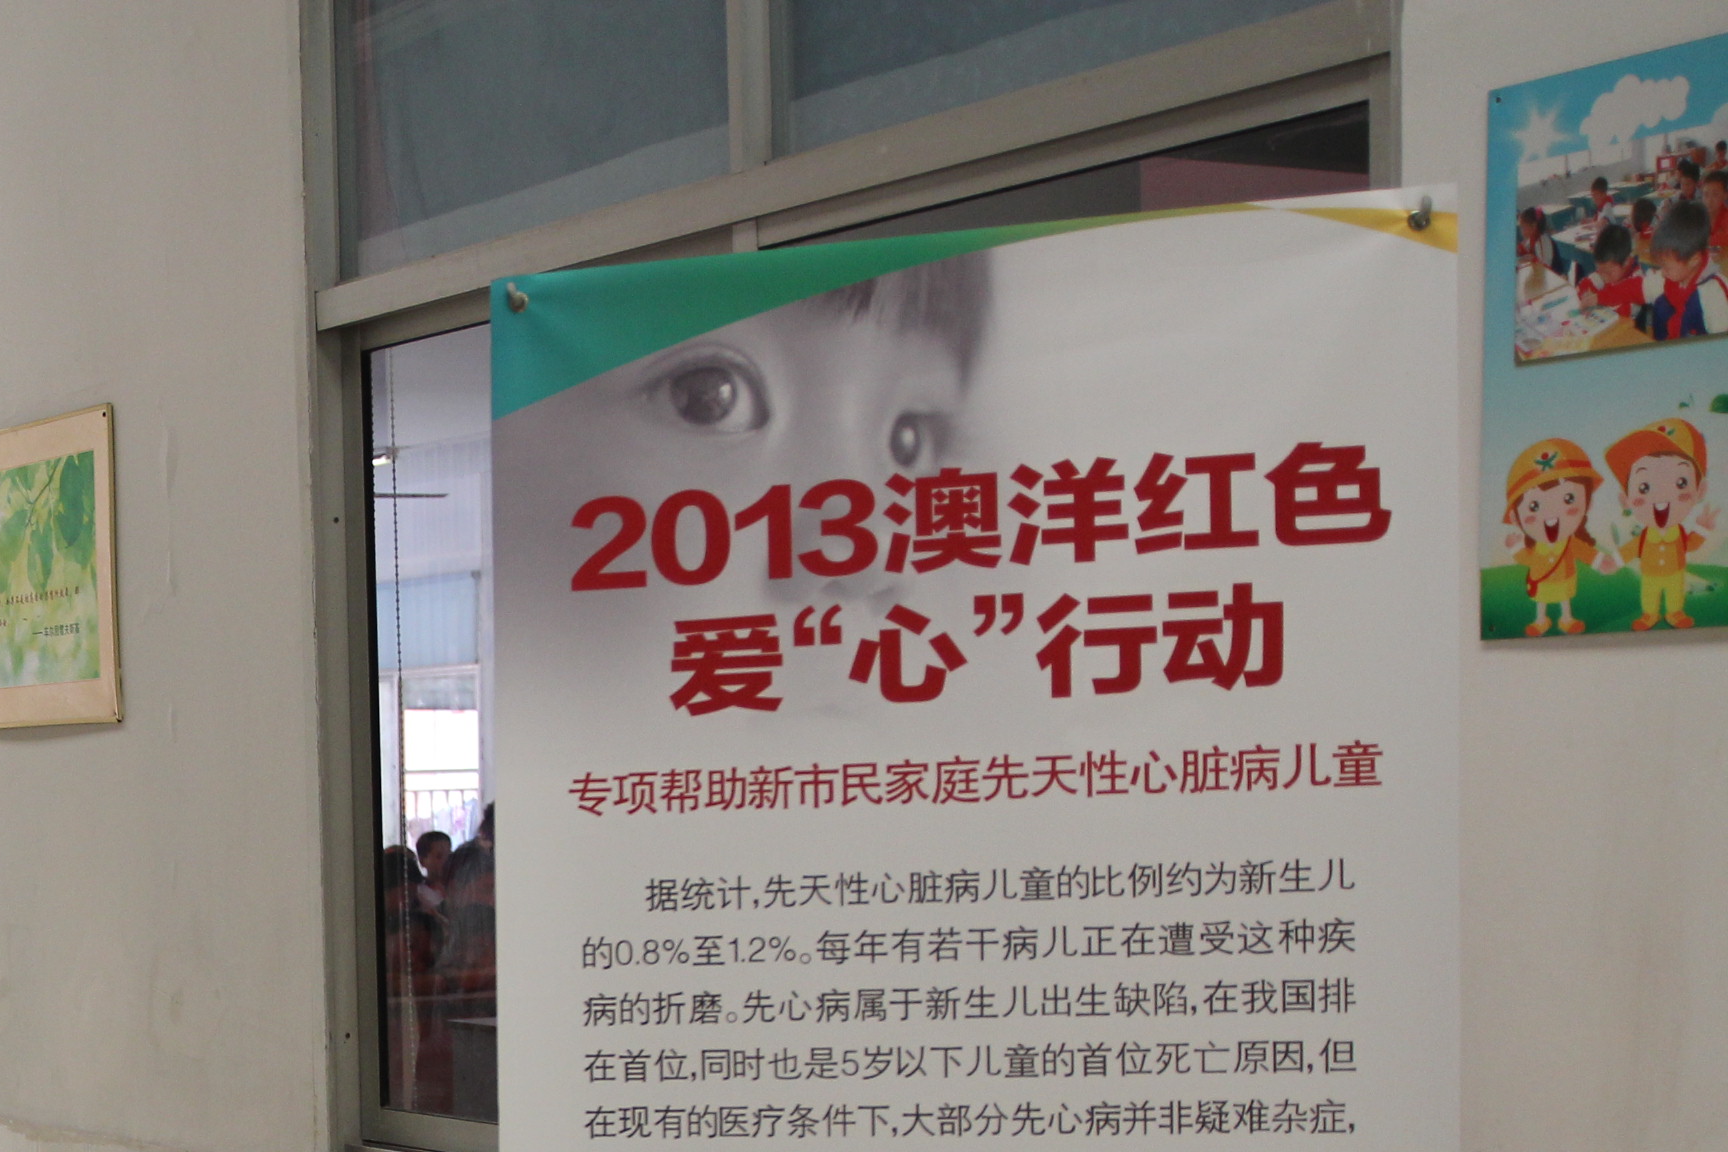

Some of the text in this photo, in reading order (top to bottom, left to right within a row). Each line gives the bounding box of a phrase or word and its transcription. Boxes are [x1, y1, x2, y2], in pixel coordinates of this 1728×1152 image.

[569, 441, 1392, 592] 2013澳洋红色
[669, 583, 1285, 717] 爱“心”行动
[568, 739, 1384, 818] 专项帮助新市民家庭先天性心脏病儿童
[645, 858, 1355, 912] 据统计，先天性心脏病儿童的比例约为新生儿
[583, 977, 1355, 1026] 病的折磨。先心病属于新生儿出生缺陷，在我国排
[584, 1037, 1355, 1083] 在首位，同时也是5岁以下儿童的首位死亡原因，但
[585, 1098, 1356, 1140] 在现有的医疗条件下，大部分先心病并非疑难杂症，
